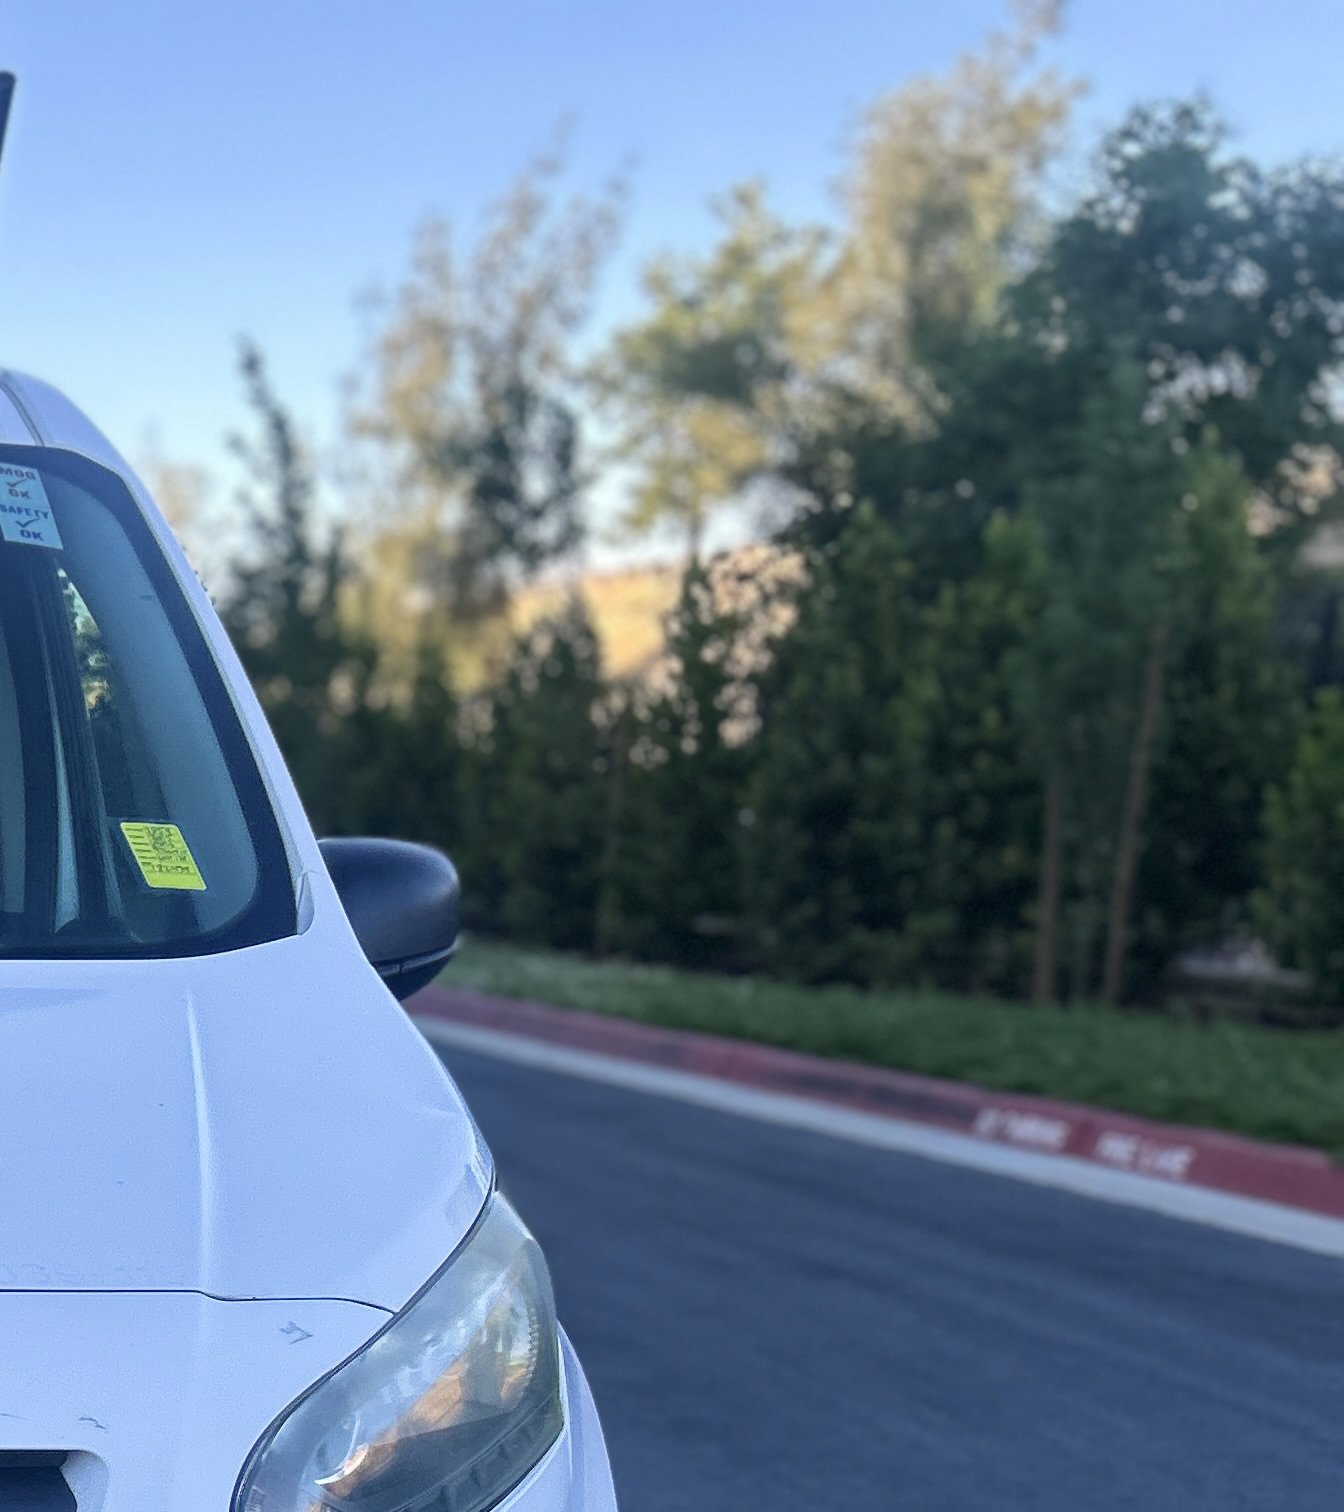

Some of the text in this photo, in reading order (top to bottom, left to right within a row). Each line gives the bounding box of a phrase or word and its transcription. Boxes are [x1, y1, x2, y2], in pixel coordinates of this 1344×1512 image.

[8, 488, 31, 499] OK
[0, 504, 49, 519] SAFETY
[19, 529, 44, 541] OK
